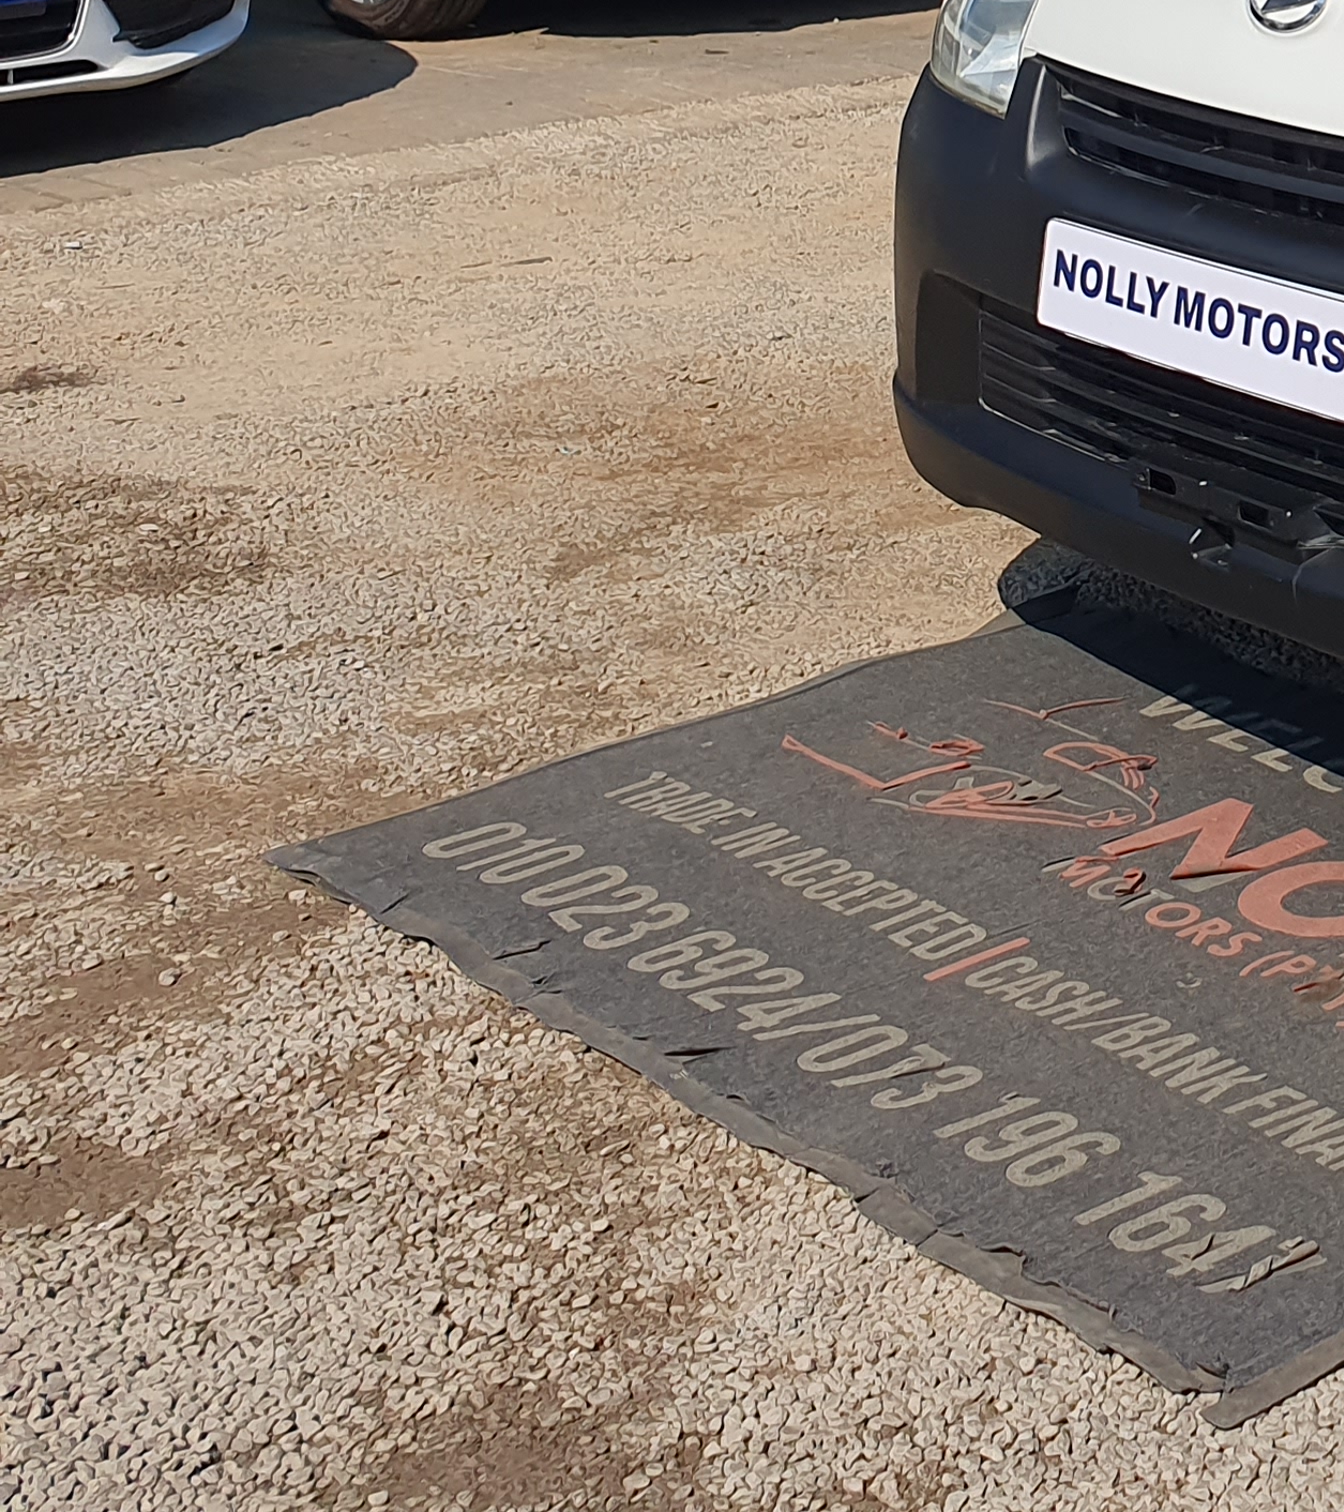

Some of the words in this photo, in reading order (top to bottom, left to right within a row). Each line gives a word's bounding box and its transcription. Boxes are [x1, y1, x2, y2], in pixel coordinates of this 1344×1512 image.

[1053, 248, 1170, 319] NOLLY
[603, 770, 758, 835] TRADE
[710, 821, 802, 860] IN
[933, 1090, 1121, 1188] 196
